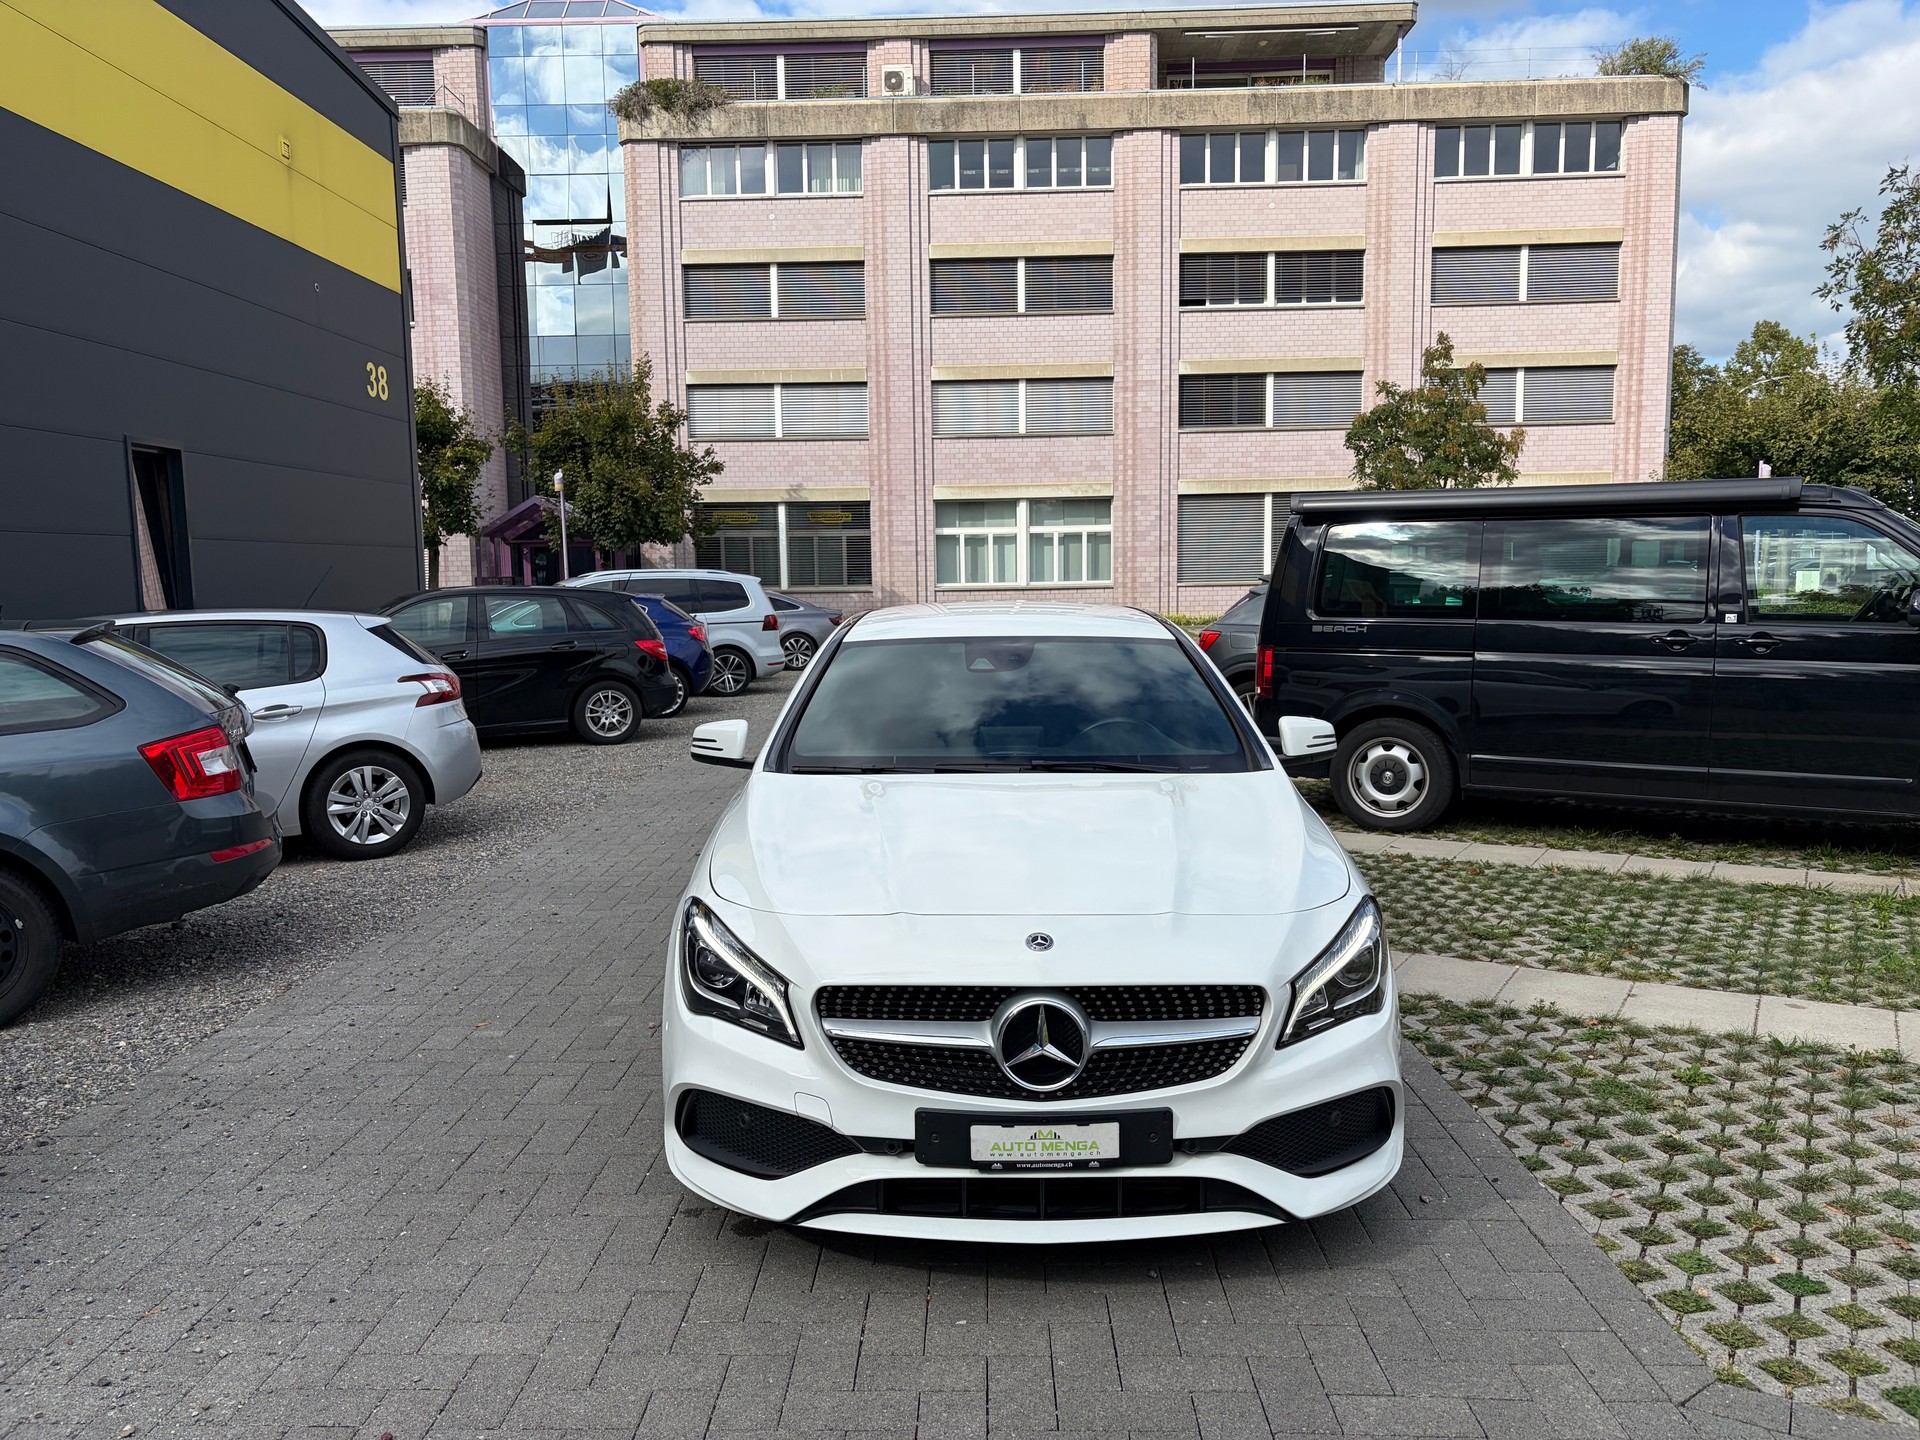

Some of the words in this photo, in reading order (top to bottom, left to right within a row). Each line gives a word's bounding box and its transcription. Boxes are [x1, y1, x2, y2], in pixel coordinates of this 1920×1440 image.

[366, 361, 389, 401] 38
[1311, 625, 1367, 633] BEACH
[990, 1141, 1036, 1152] AUTO
[1041, 1140, 1100, 1151] MENGA
